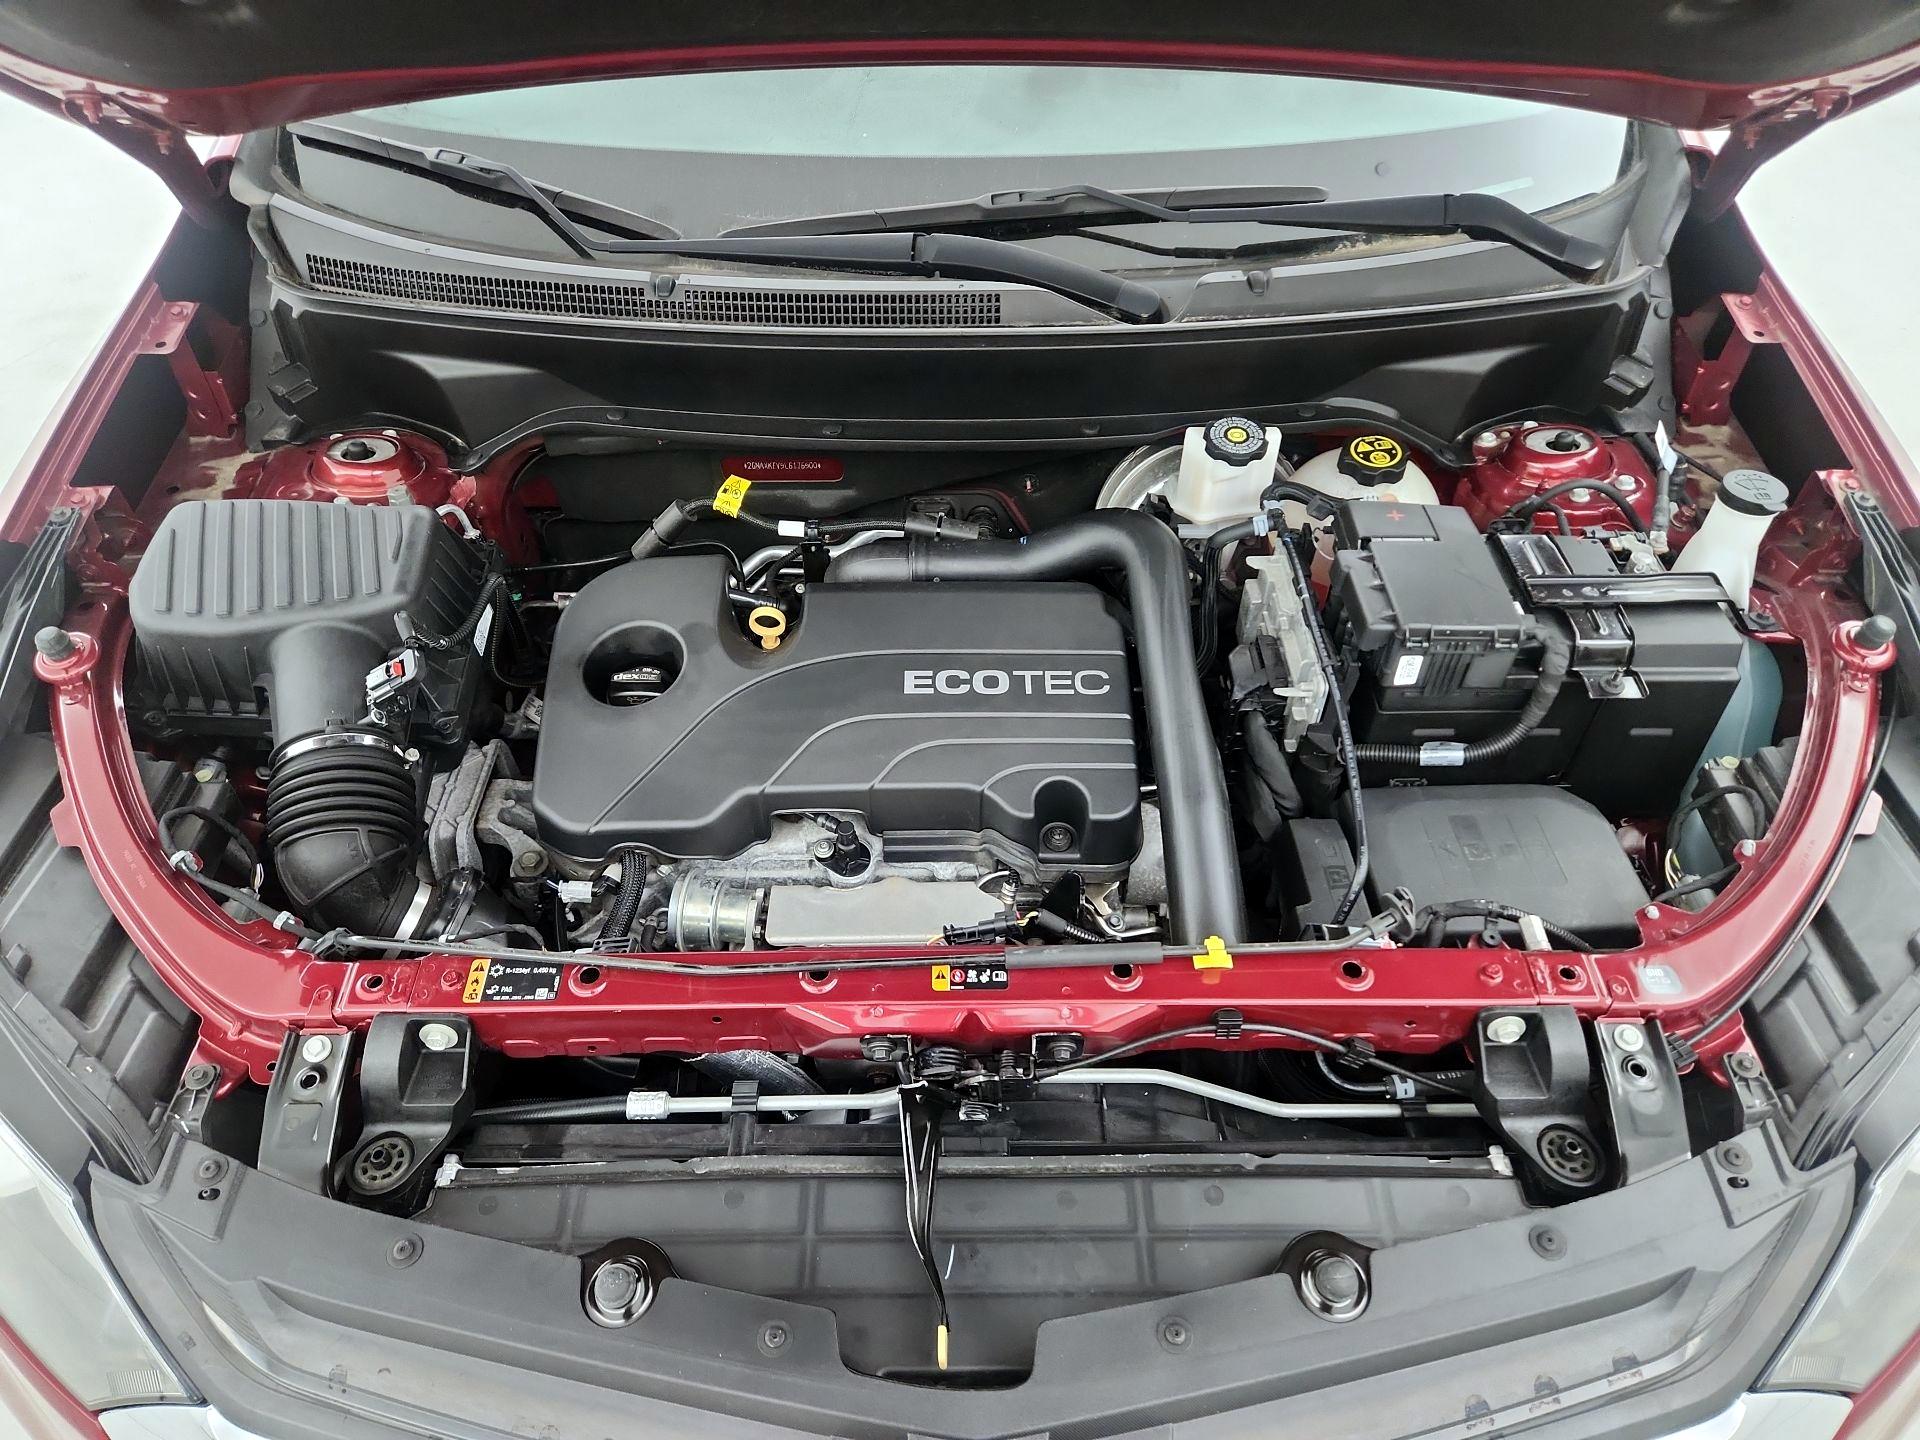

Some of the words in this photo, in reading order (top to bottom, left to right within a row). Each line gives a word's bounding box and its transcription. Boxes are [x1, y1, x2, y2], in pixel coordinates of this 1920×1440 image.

[613, 673, 658, 681] dexos
[903, 669, 1111, 695] ECOTEC
[549, 966, 557, 974] kg
